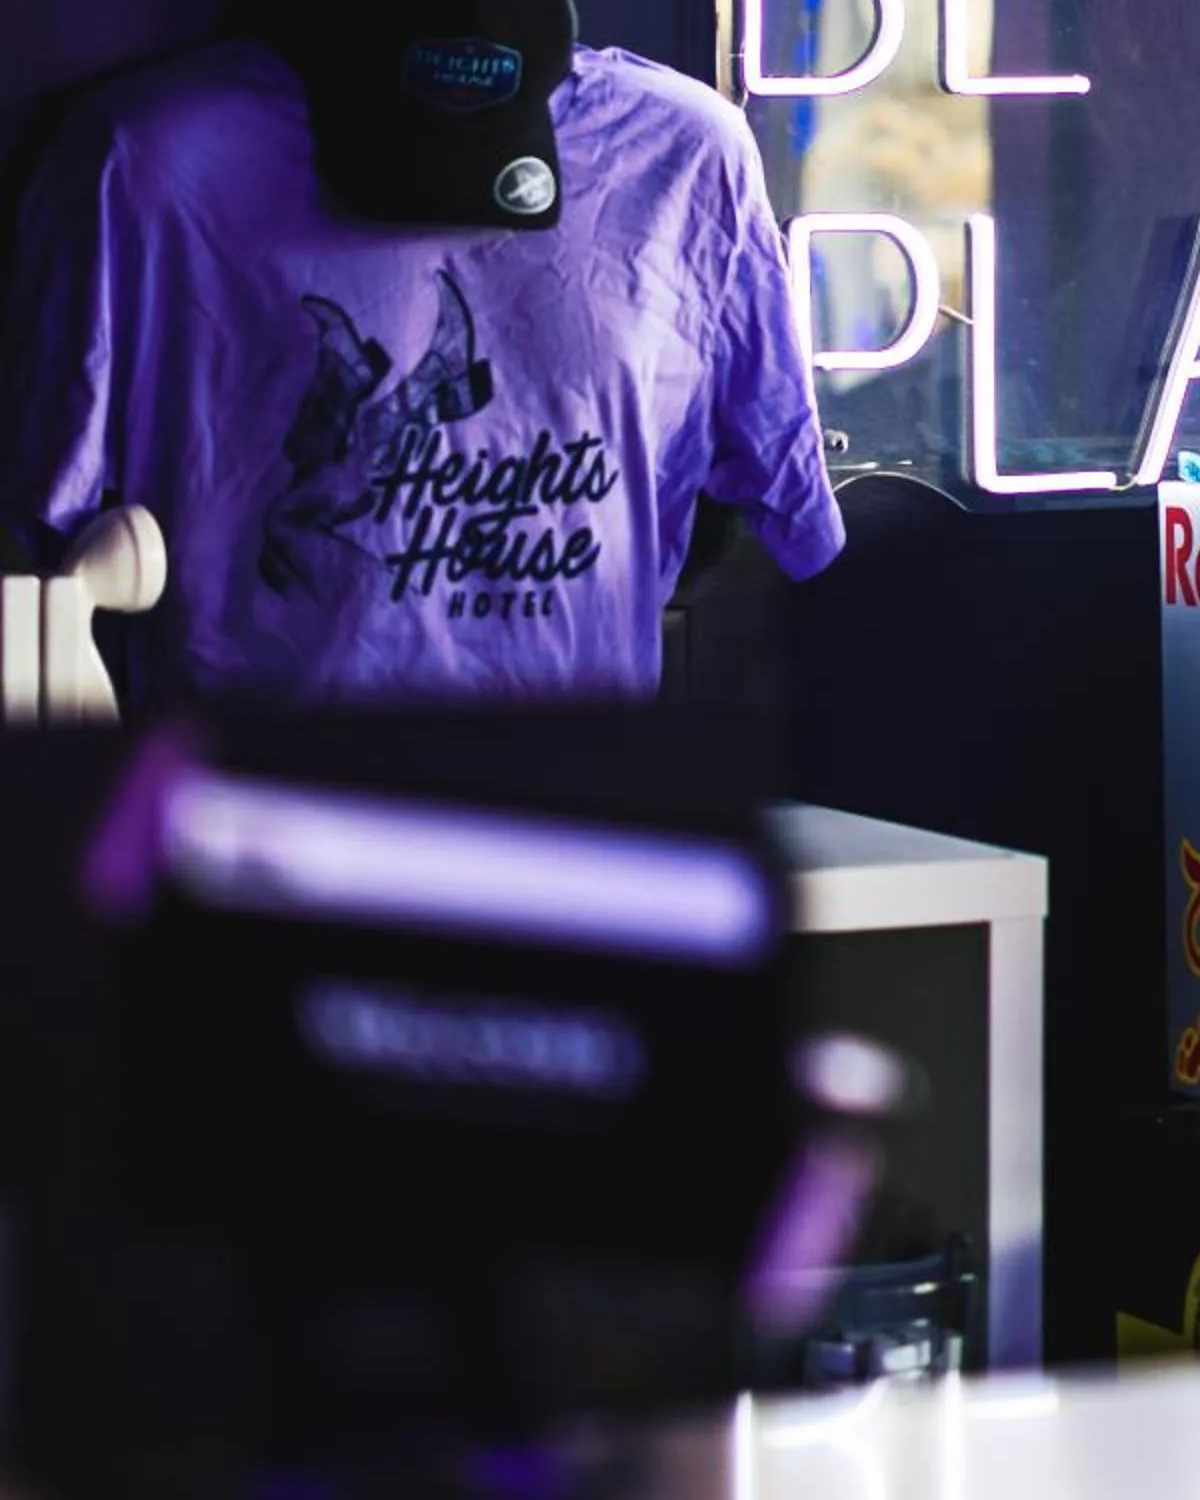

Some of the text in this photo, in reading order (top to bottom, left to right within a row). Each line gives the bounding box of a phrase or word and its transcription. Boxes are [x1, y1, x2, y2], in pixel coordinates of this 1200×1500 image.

[371, 422, 620, 540] Heights
[385, 504, 602, 604] House
[446, 589, 554, 619] HOTEL
